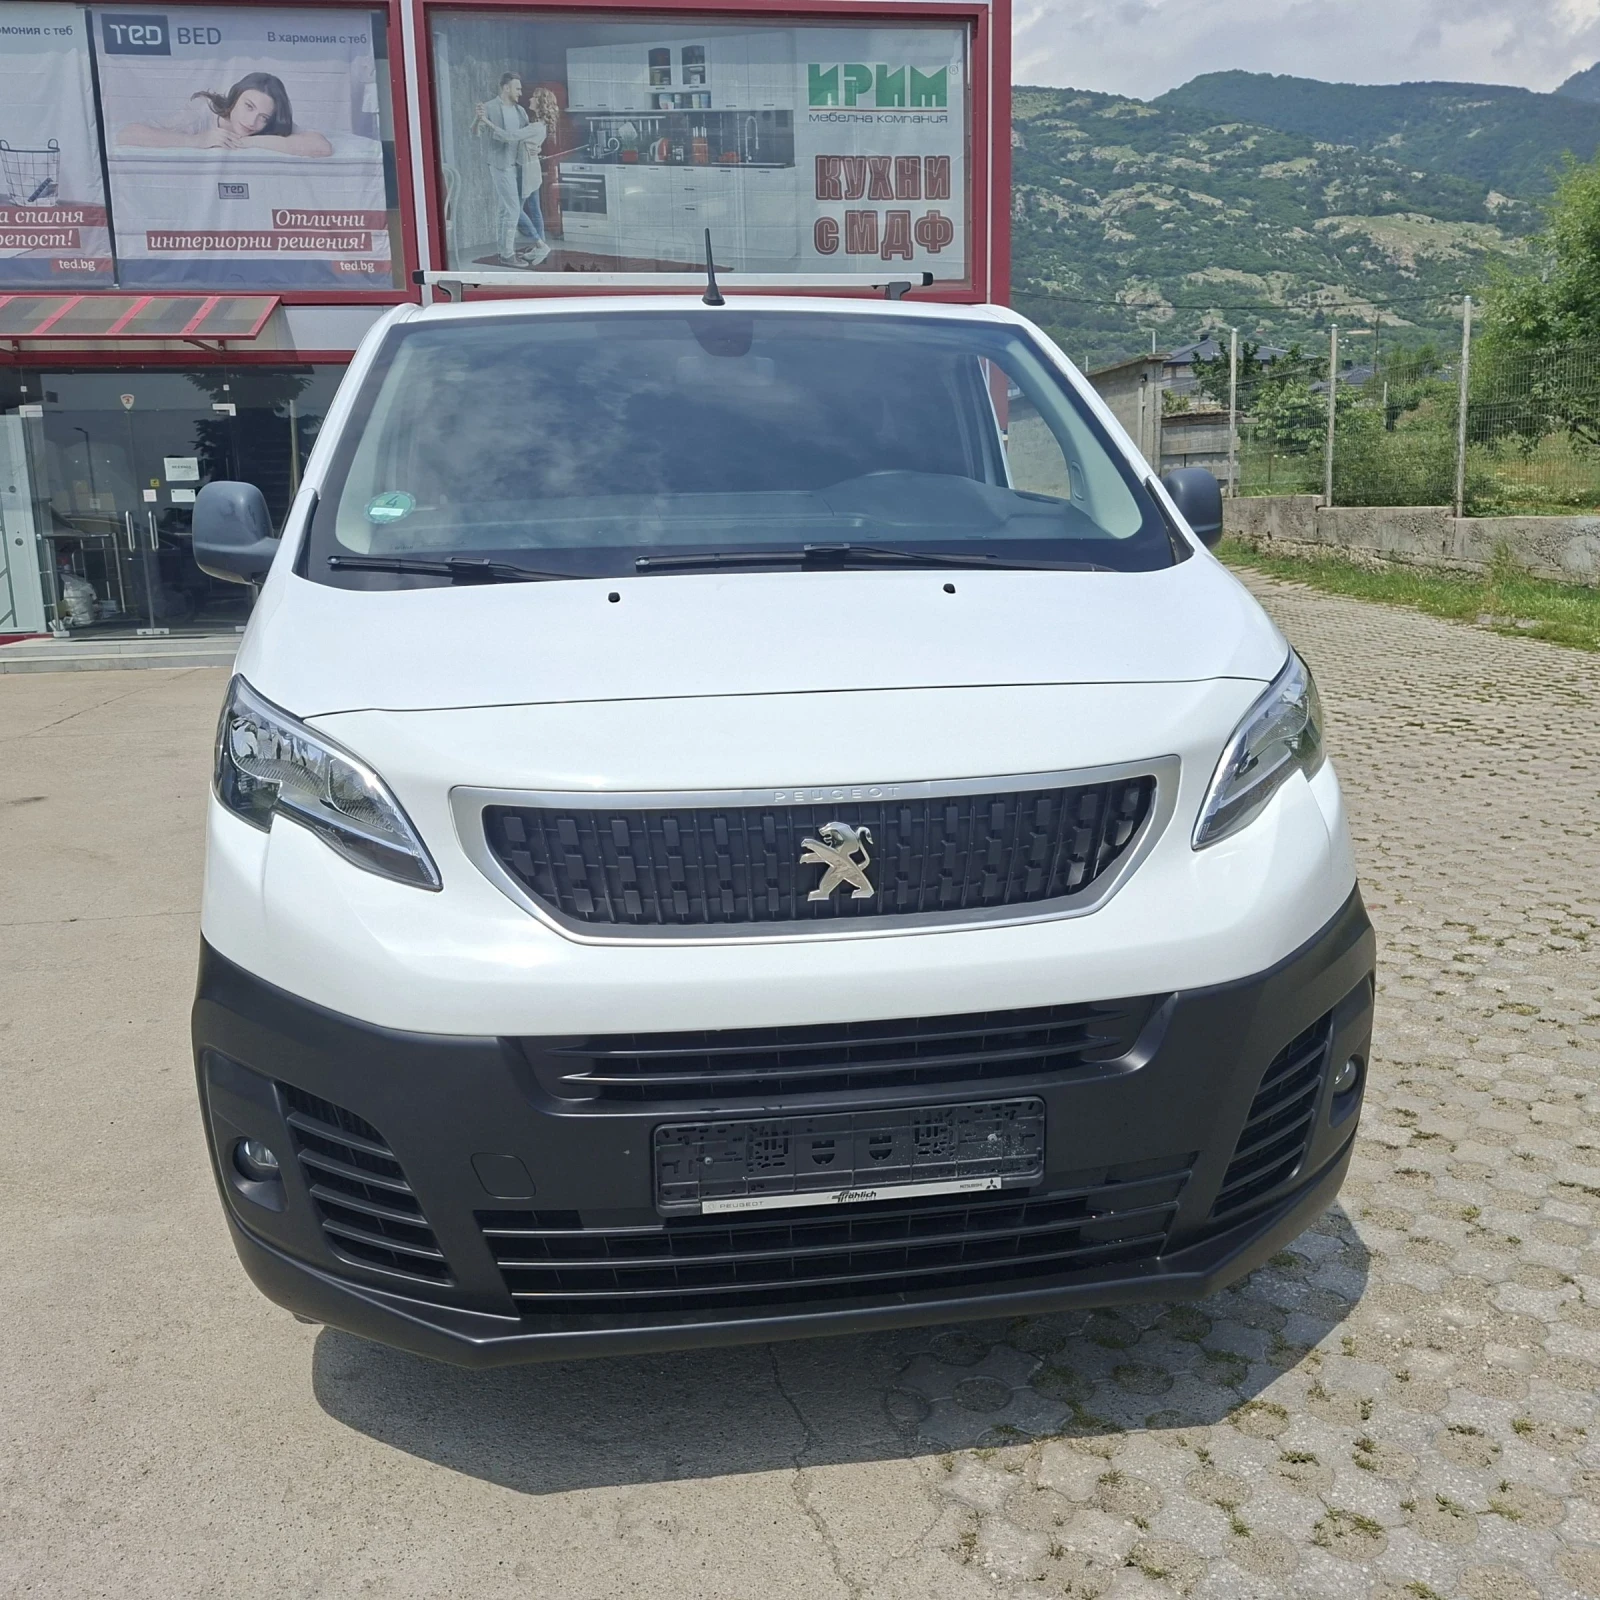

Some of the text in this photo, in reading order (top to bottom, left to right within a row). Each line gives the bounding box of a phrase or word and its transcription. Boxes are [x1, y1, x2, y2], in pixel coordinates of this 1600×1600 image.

[0, 25, 73, 36] мония с теб
[177, 27, 222, 45] BED
[267, 31, 367, 45] В хармония с теб
[808, 64, 947, 107] ИРИМ
[808, 112, 948, 124] мебелна компания
[815, 155, 951, 200] КУХНИ
[15, 210, 84, 223] спалня
[276, 210, 365, 227] Отлични
[150, 233, 366, 251] интериорни решения!
[58, 259, 96, 272] ted.bg
[340, 261, 375, 273] ted.bg
[385, 494, 400, 507] 4
[773, 787, 900, 803] PEUGEOT
[719, 1201, 764, 1209] PEUGEOT
